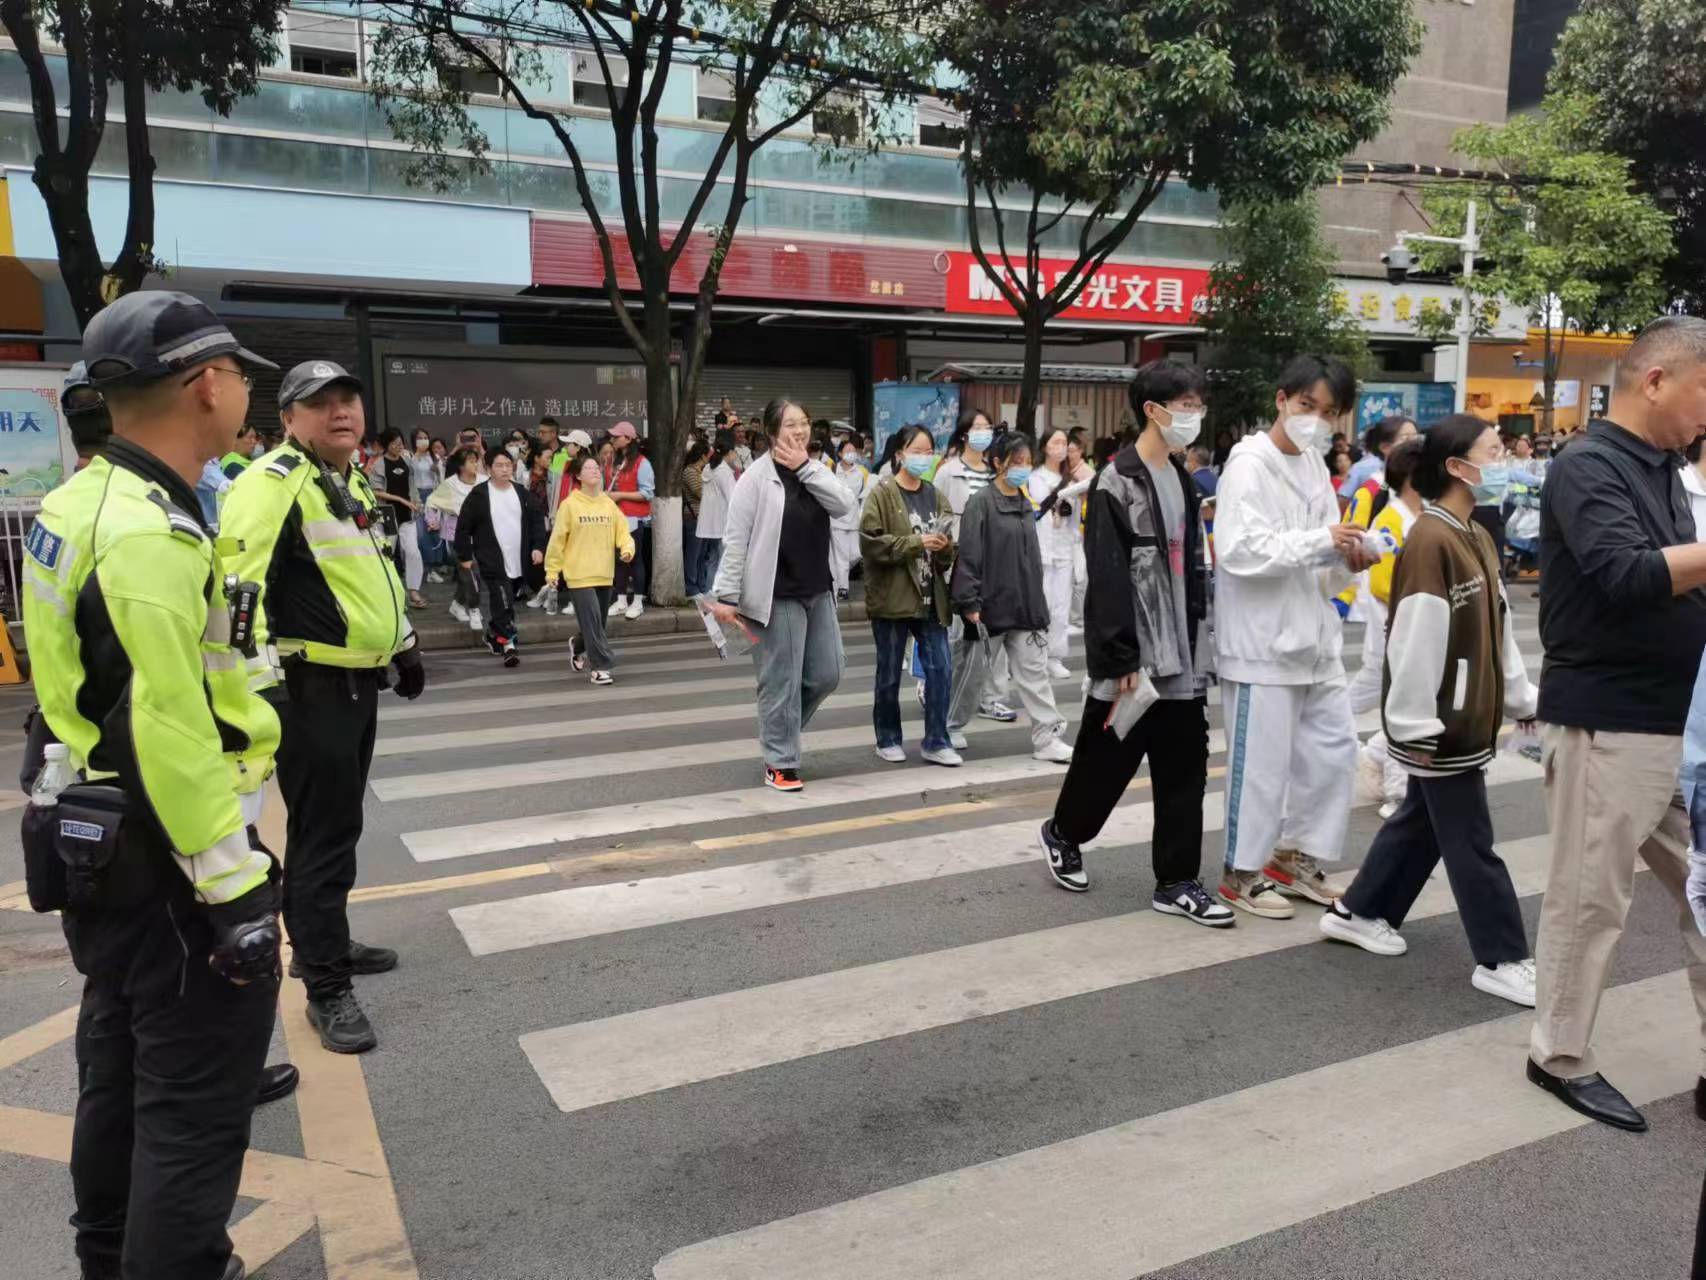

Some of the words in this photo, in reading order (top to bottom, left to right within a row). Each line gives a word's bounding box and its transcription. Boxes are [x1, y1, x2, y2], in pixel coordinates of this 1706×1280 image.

[418, 396, 536, 417] 凿非凡之作品
